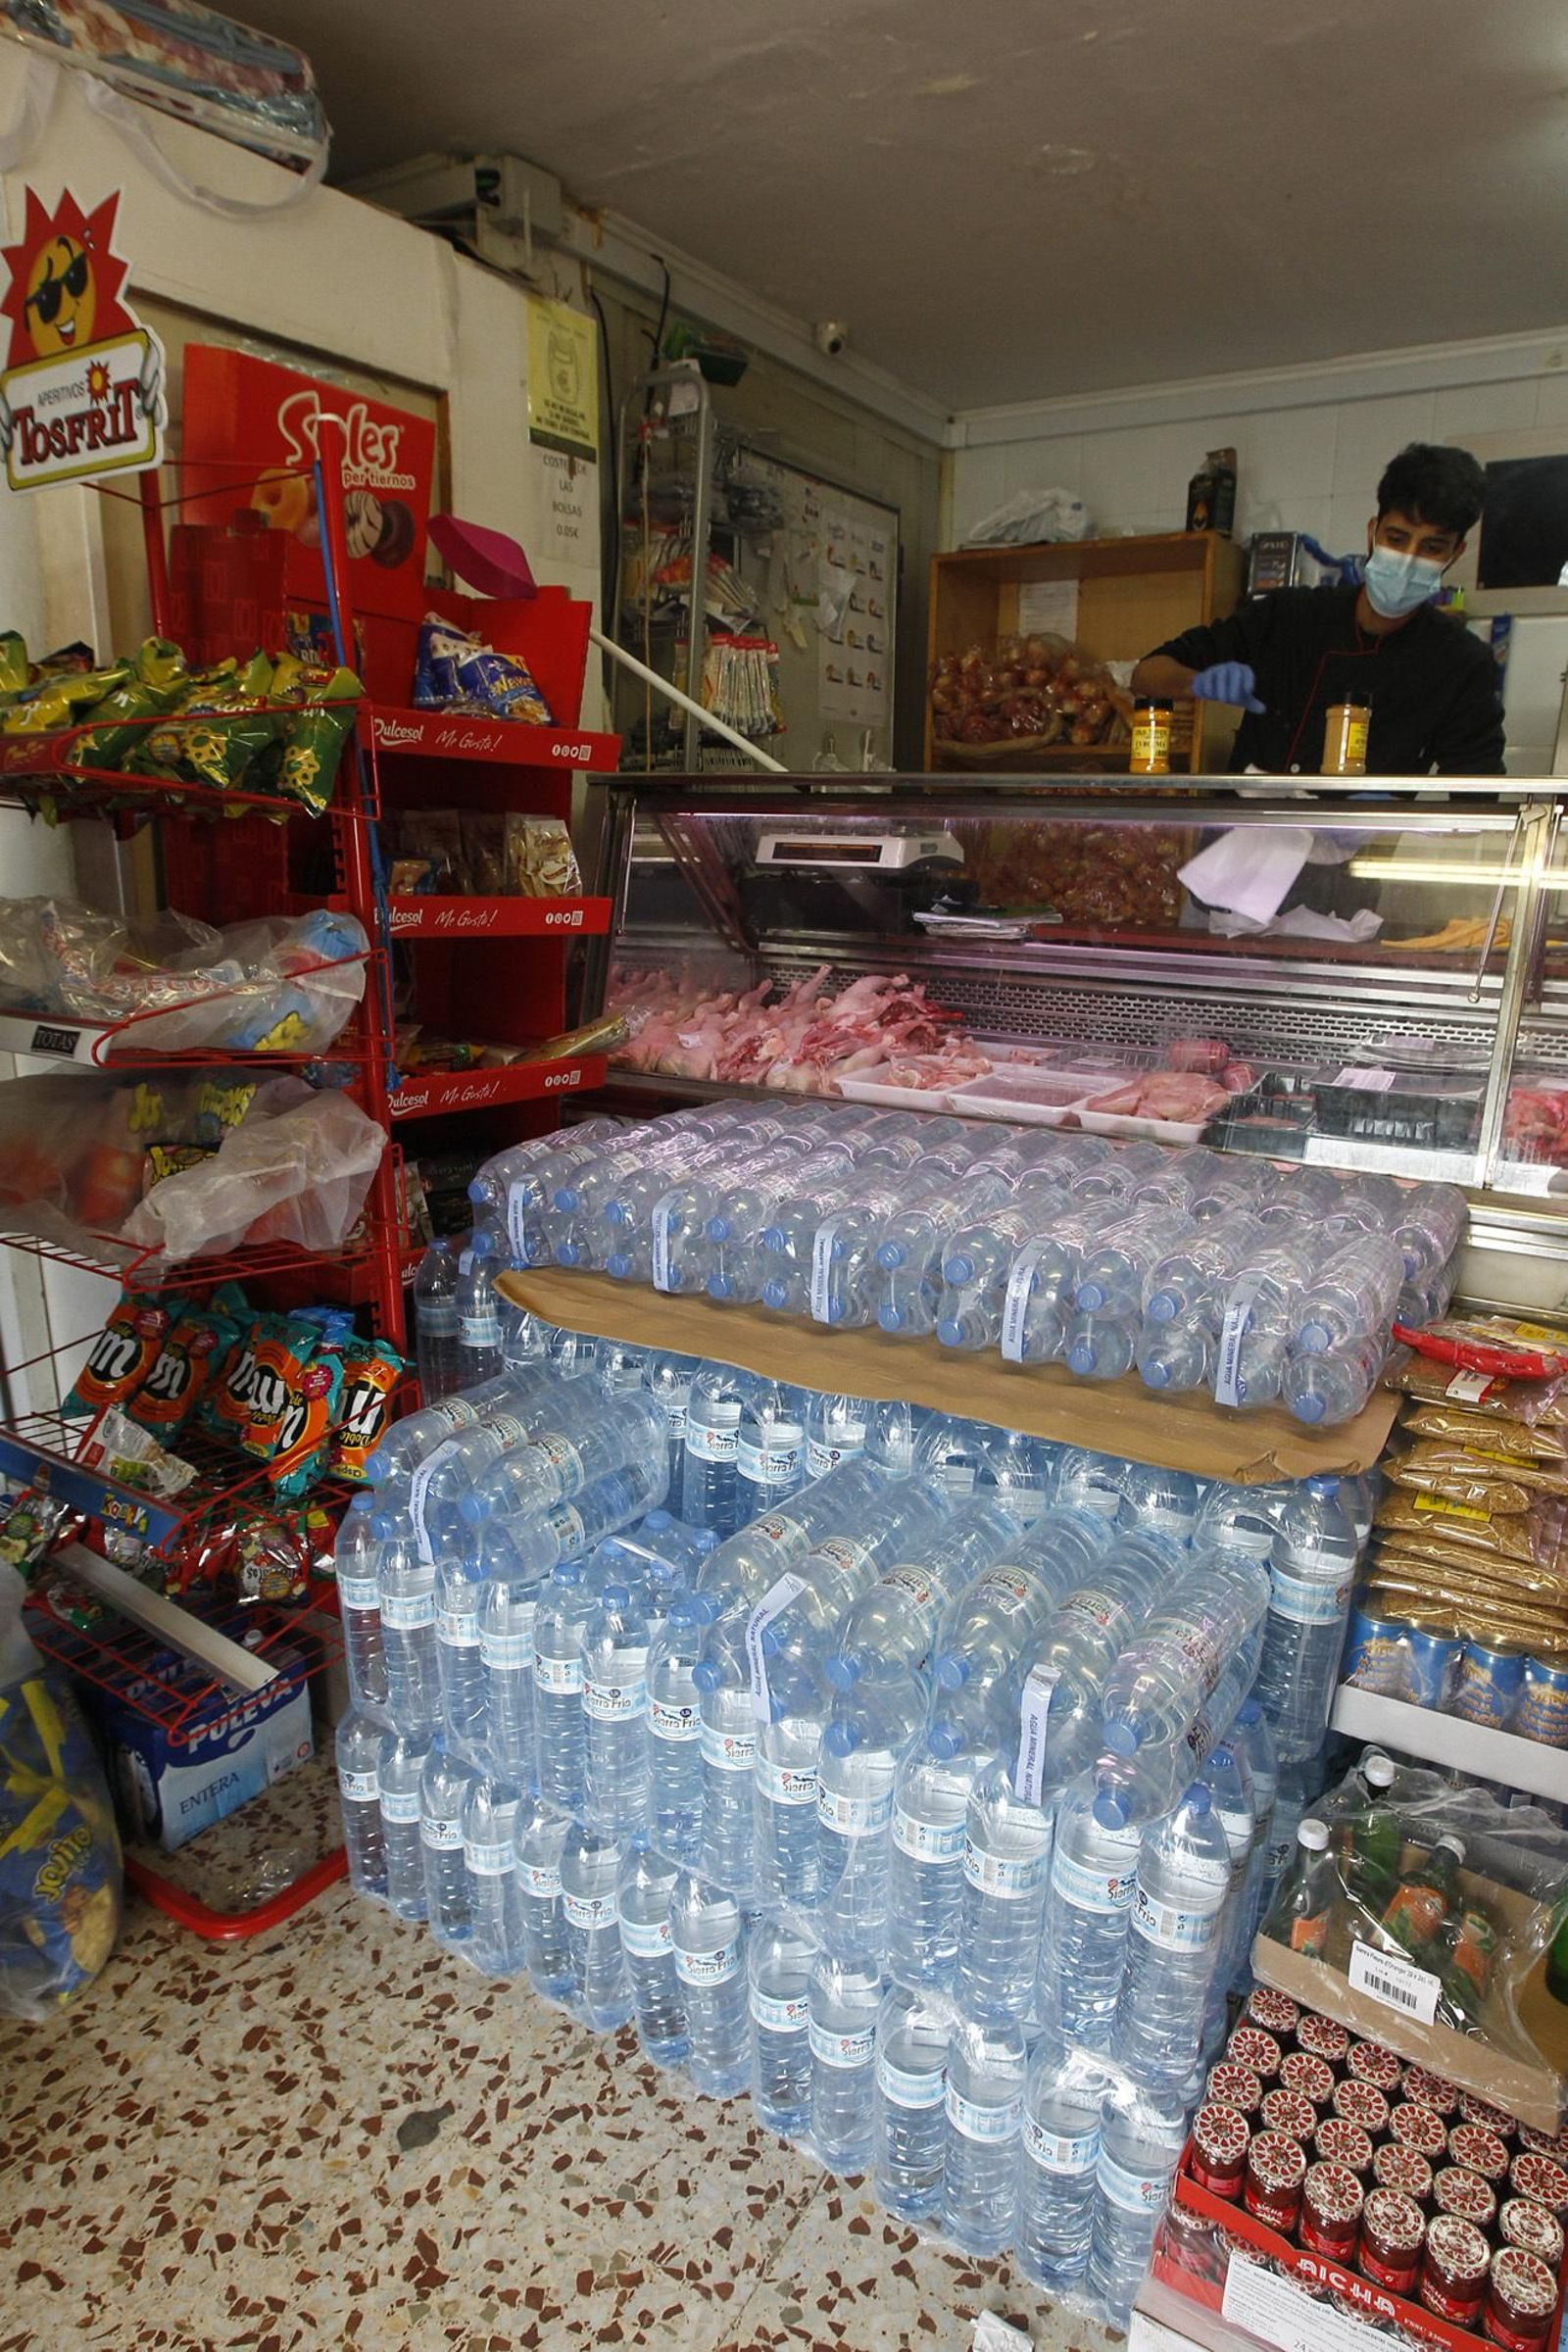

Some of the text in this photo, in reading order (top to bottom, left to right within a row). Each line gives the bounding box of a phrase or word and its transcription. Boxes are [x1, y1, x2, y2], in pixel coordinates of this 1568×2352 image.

[11, 378, 140, 466] TOSFRIT
[552, 502, 582, 516] BOLSAS
[374, 717, 423, 742] Dulcesol
[374, 906, 422, 926] Dlcesol
[750, 1608, 769, 1642] NATURAL
[1026, 1737, 1038, 1771] MINERAL
[179, 1772, 240, 1815] ENTERA
[1023, 1771, 1033, 1802] NATURA
[1297, 2258, 1396, 2317] AICHA
